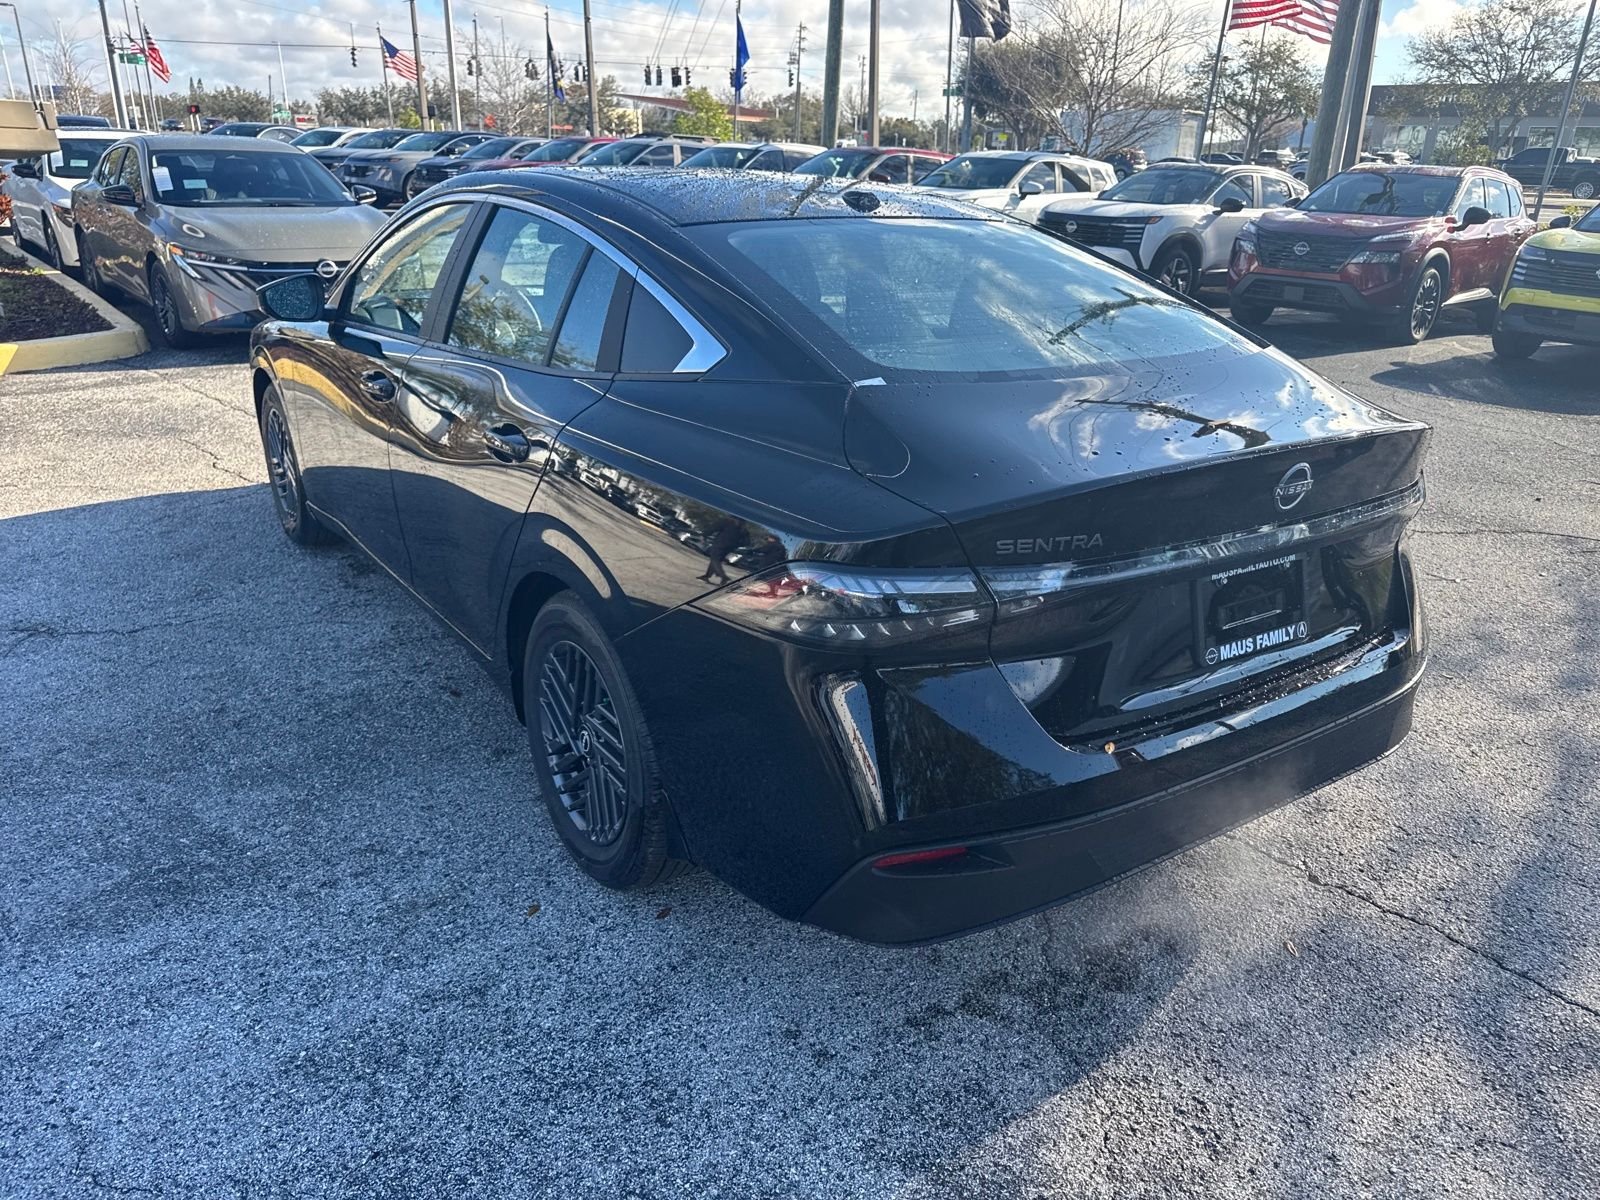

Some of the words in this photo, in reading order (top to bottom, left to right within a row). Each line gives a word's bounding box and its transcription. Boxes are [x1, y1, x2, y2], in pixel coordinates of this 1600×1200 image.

[1275, 483, 1312, 496] NISSAN
[996, 533, 1103, 555] SENTRA
[1220, 637, 1254, 661] MAUS
[1256, 625, 1296, 650] FAMILY
